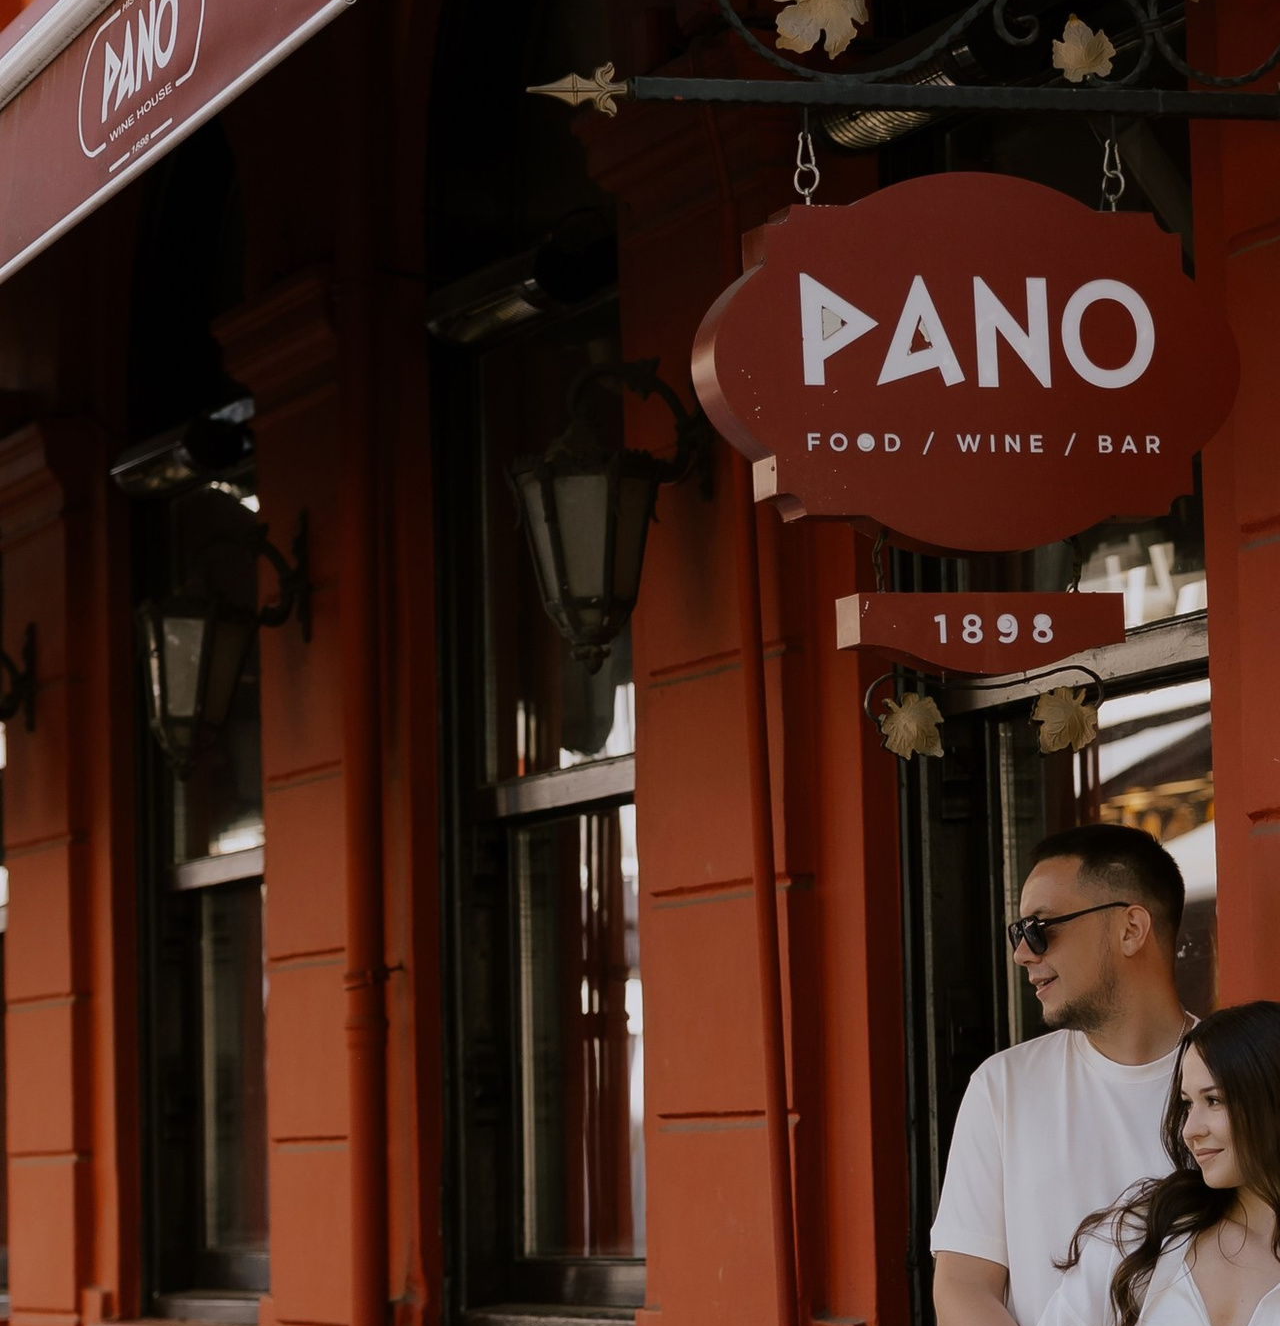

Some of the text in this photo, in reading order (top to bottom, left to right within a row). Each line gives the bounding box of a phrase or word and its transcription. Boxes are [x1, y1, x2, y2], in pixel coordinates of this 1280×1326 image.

[109, 82, 173, 142] WINE HOUSE
[131, 134, 150, 155] 1898
[799, 271, 1156, 389] PANO
[806, 432, 901, 453] FOOD
[956, 433, 1043, 454] WINE
[1098, 434, 1161, 454] BAR
[933, 613, 1055, 644] 1898
